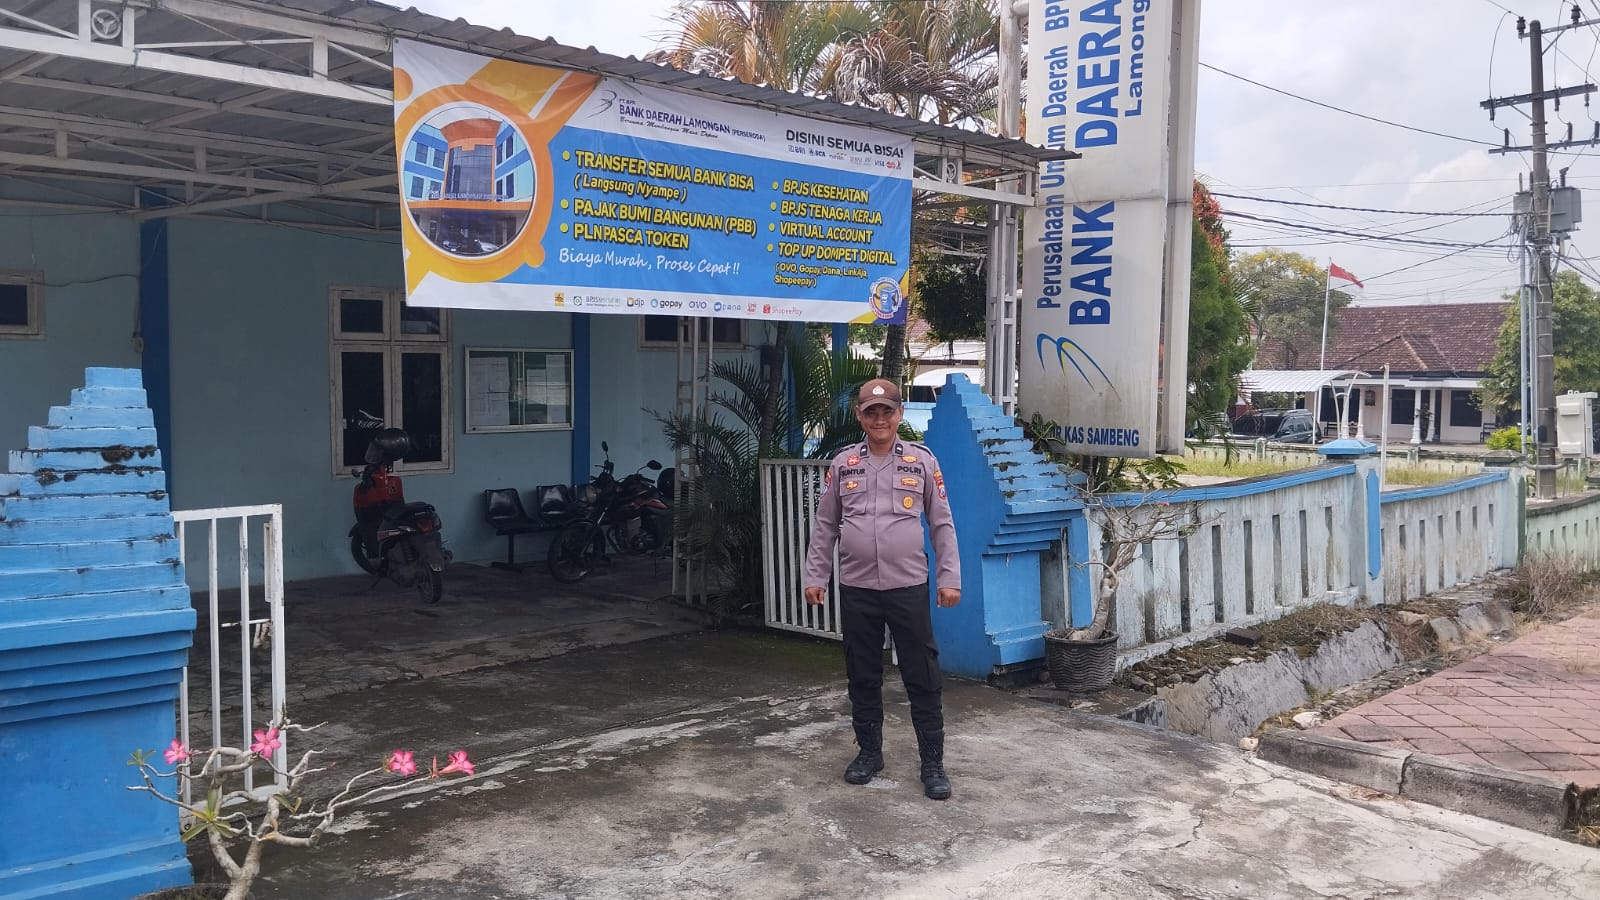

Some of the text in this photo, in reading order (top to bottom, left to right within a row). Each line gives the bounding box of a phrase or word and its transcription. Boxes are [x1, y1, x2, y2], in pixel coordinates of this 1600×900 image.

[1045, 0, 1069, 32] BP
[1042, 45, 1068, 118] Daerah
[619, 104, 644, 119] BANK
[646, 109, 681, 125] DAERAH
[683, 117, 730, 134] LAMONGAN
[786, 129, 904, 158] DISINI SEMUA BISA!
[575, 150, 755, 191] TRANSFER SEMUA BANK BISA
[783, 179, 869, 204] BPJS KESEHATAN
[574, 199, 757, 237] PAJAK BUMI BANGUNAN (PBB)
[781, 201, 883, 225] BPJS TENAGA KERJA
[574, 223, 689, 249] PLN PASCA TOKEN
[779, 222, 873, 243] VIRTUAL ACCOUNT
[559, 247, 602, 269] Biaya
[605, 250, 652, 271] Murah,
[656, 255, 696, 272] Proses
[697, 258, 731, 277] Cepat
[778, 242, 897, 265] TOP UP DOMPET DIGITAL
[1037, 195, 1064, 308] Perusahaan
[1069, 201, 1115, 325] BANK
[634, 297, 644, 307] djp
[660, 300, 683, 309] gopay
[689, 301, 707, 309] OVO
[1065, 426, 1084, 443] KAS
[1087, 427, 1139, 447] SAMBENG
[897, 465, 922, 474] POLRI
